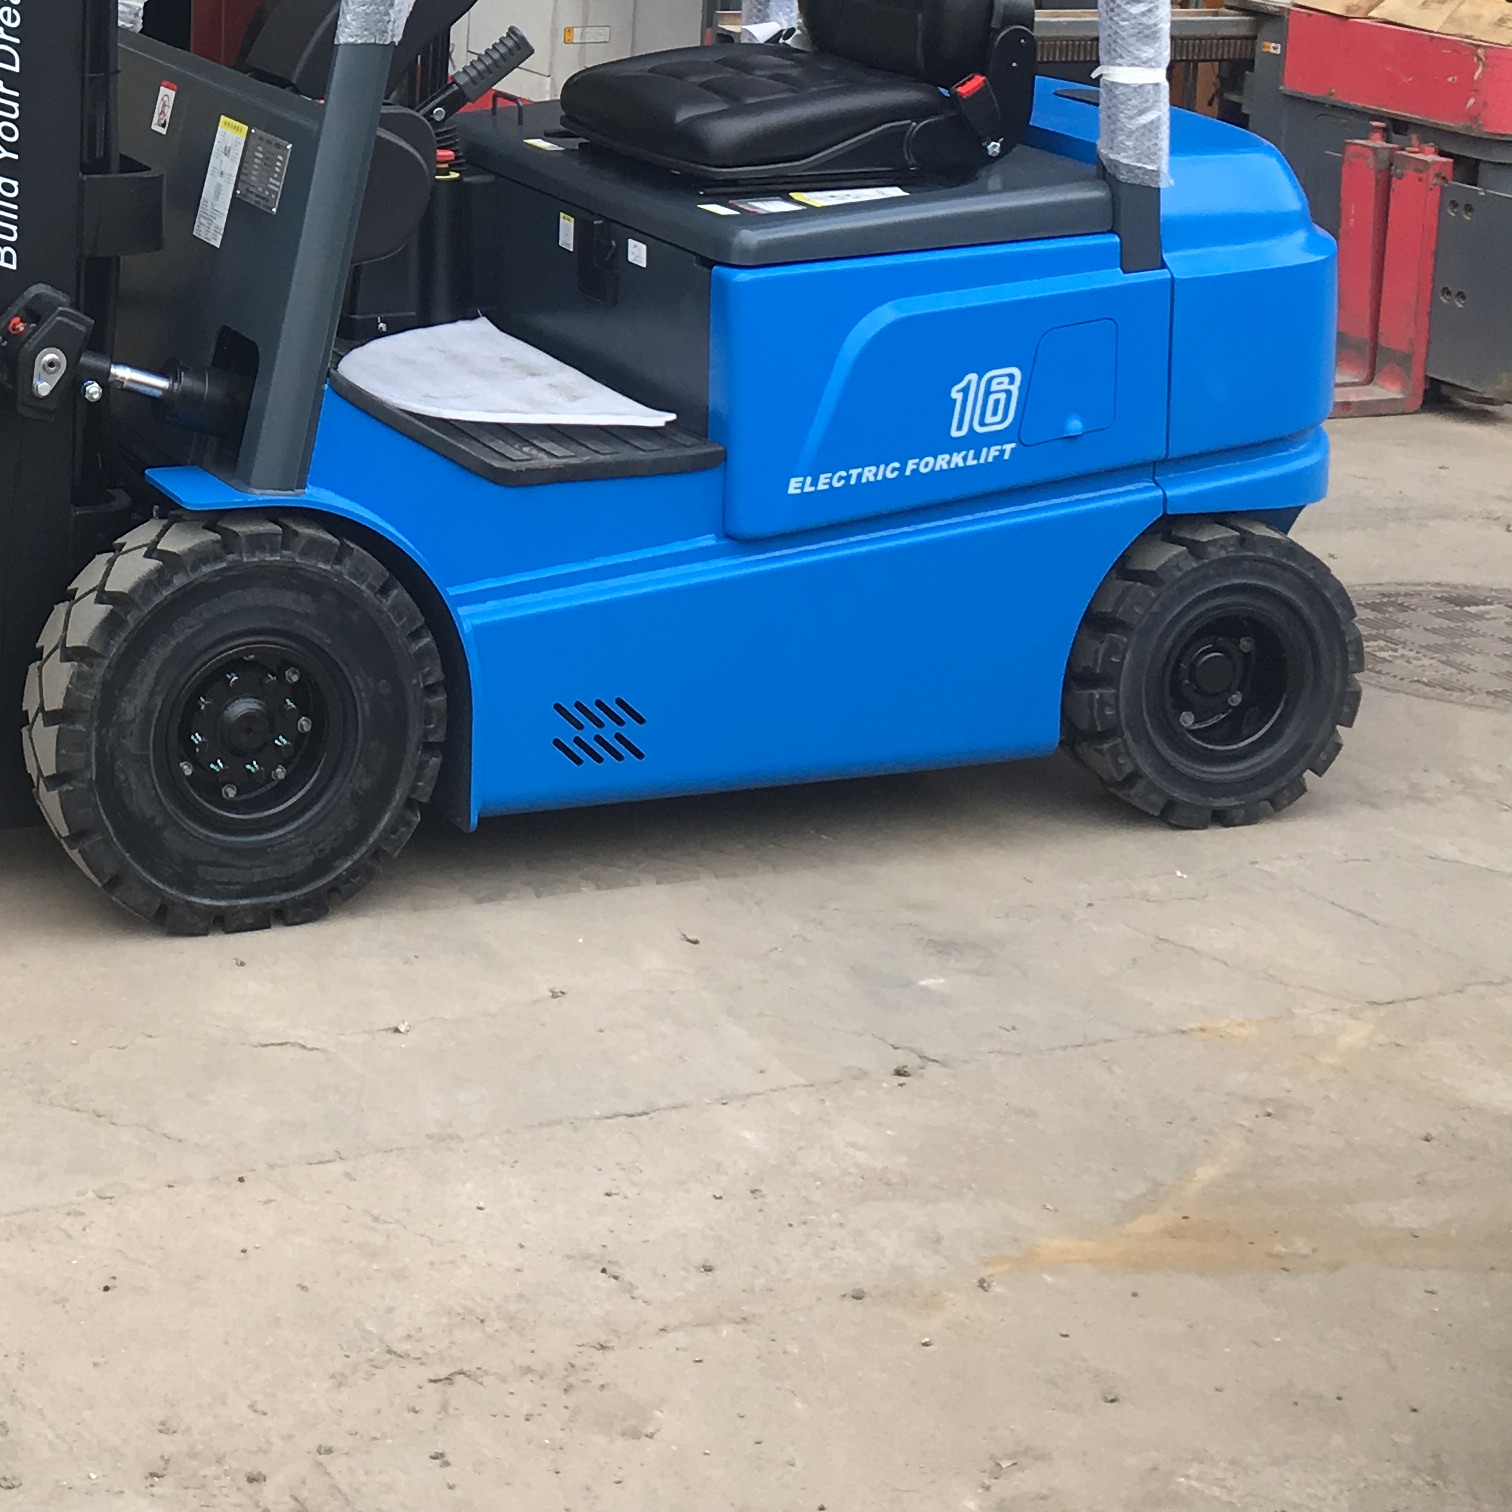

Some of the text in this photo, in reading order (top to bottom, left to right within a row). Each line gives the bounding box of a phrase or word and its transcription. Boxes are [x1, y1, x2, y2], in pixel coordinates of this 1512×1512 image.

[949, 366, 1022, 437] 16
[787, 442, 1017, 494] ELECTRIC FORKLIFT
